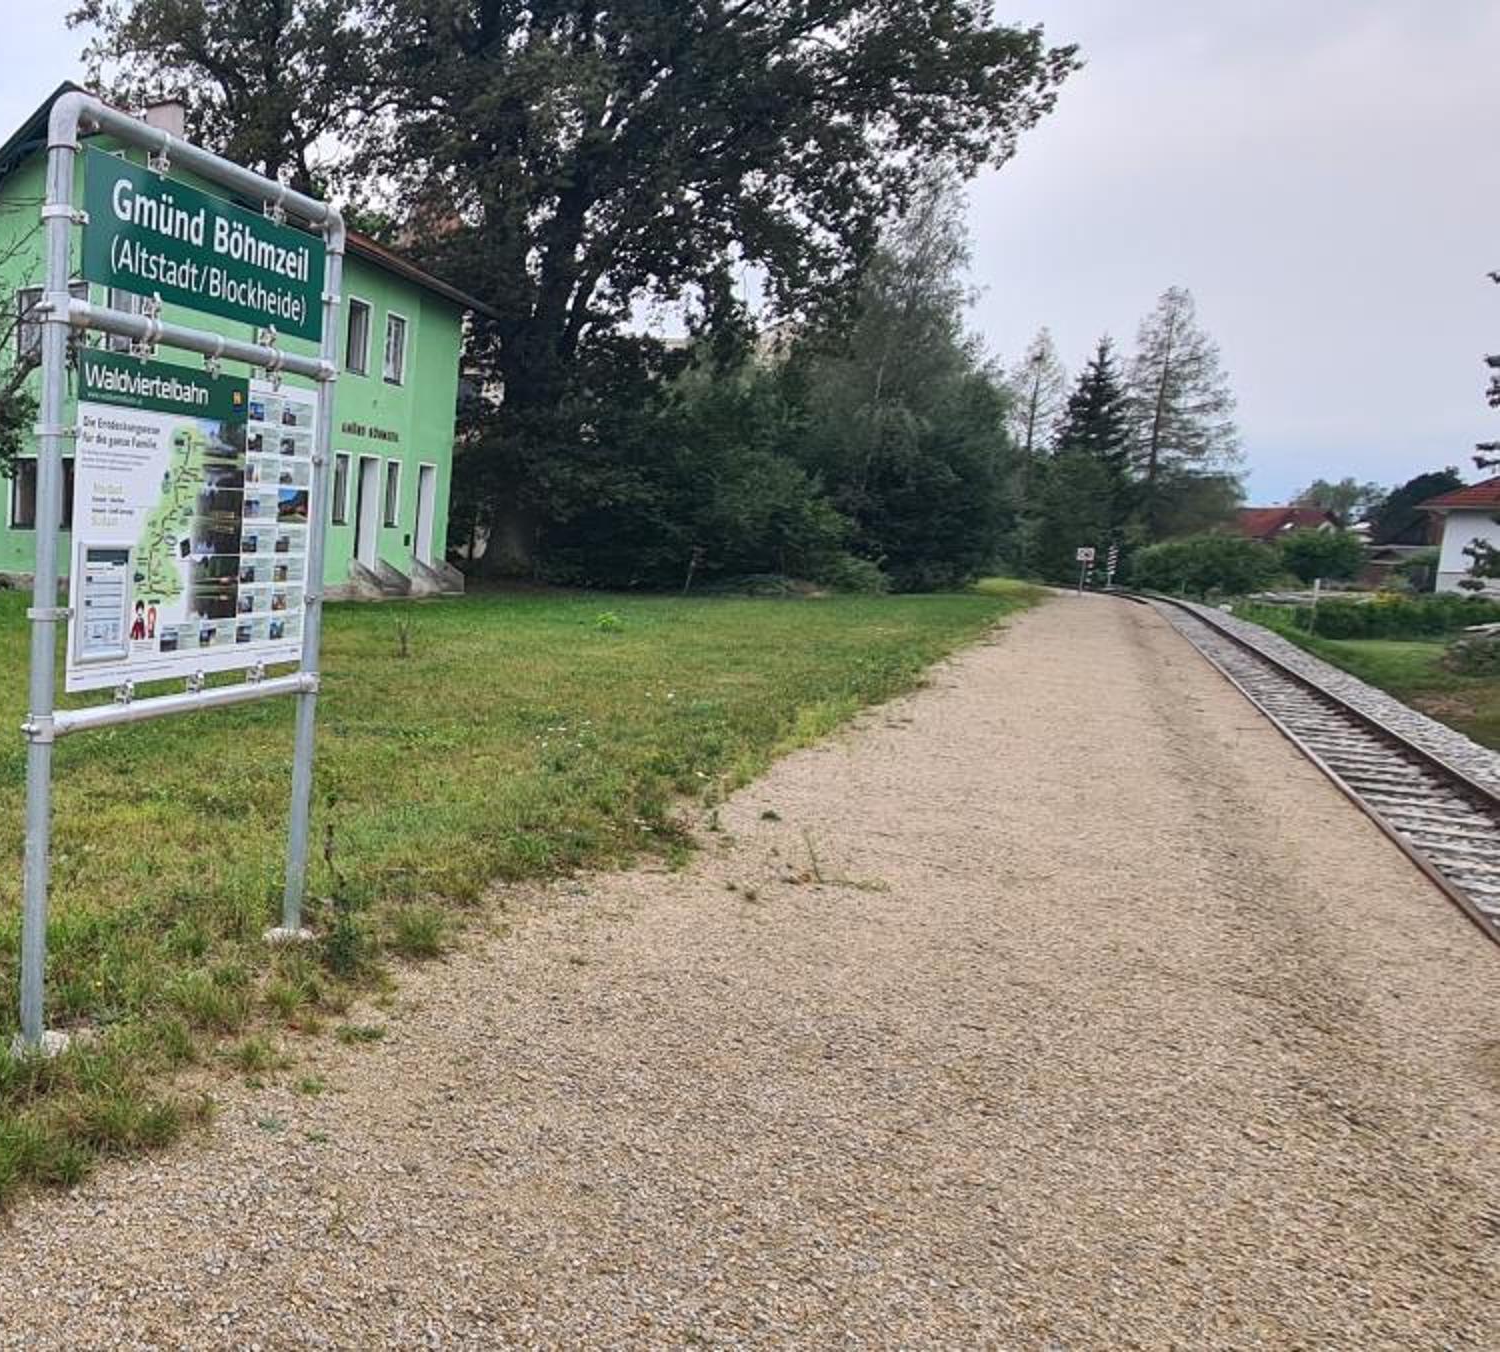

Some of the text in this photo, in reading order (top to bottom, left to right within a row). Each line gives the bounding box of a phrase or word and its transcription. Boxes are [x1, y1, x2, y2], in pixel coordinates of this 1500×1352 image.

[113, 178, 309, 282] Gmünd Böhmzeil
[110, 234, 306, 328] (Altstadt/Blockheide)
[85, 361, 209, 405] Waldviertelbahn
